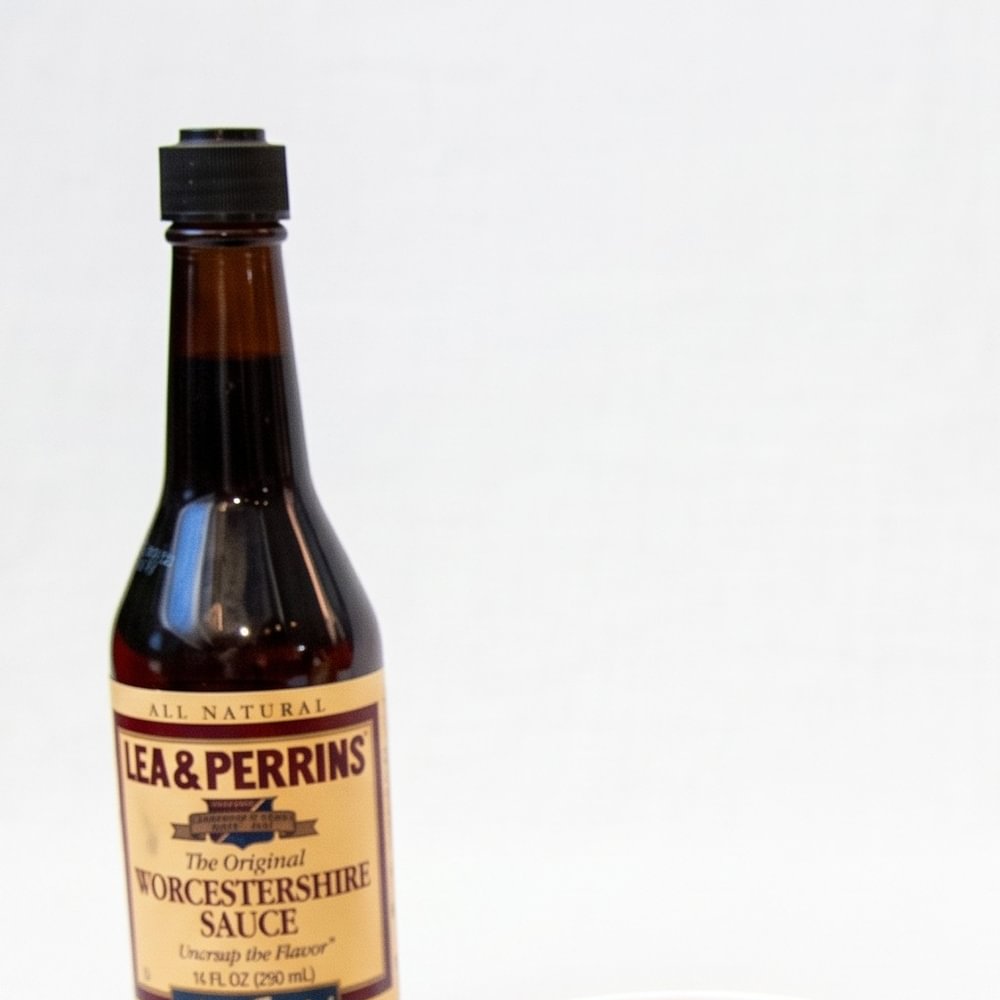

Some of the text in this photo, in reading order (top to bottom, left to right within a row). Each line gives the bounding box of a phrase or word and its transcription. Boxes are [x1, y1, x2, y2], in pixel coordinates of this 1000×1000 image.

[149, 699, 326, 721] ALL NATURAL
[186, 848, 306, 875] The Original
[135, 861, 371, 907] WORCESTERSHIRE
[200, 908, 298, 938] SAUCE
[246, 946, 270, 961] the
[229, 972, 249, 987] OZ
